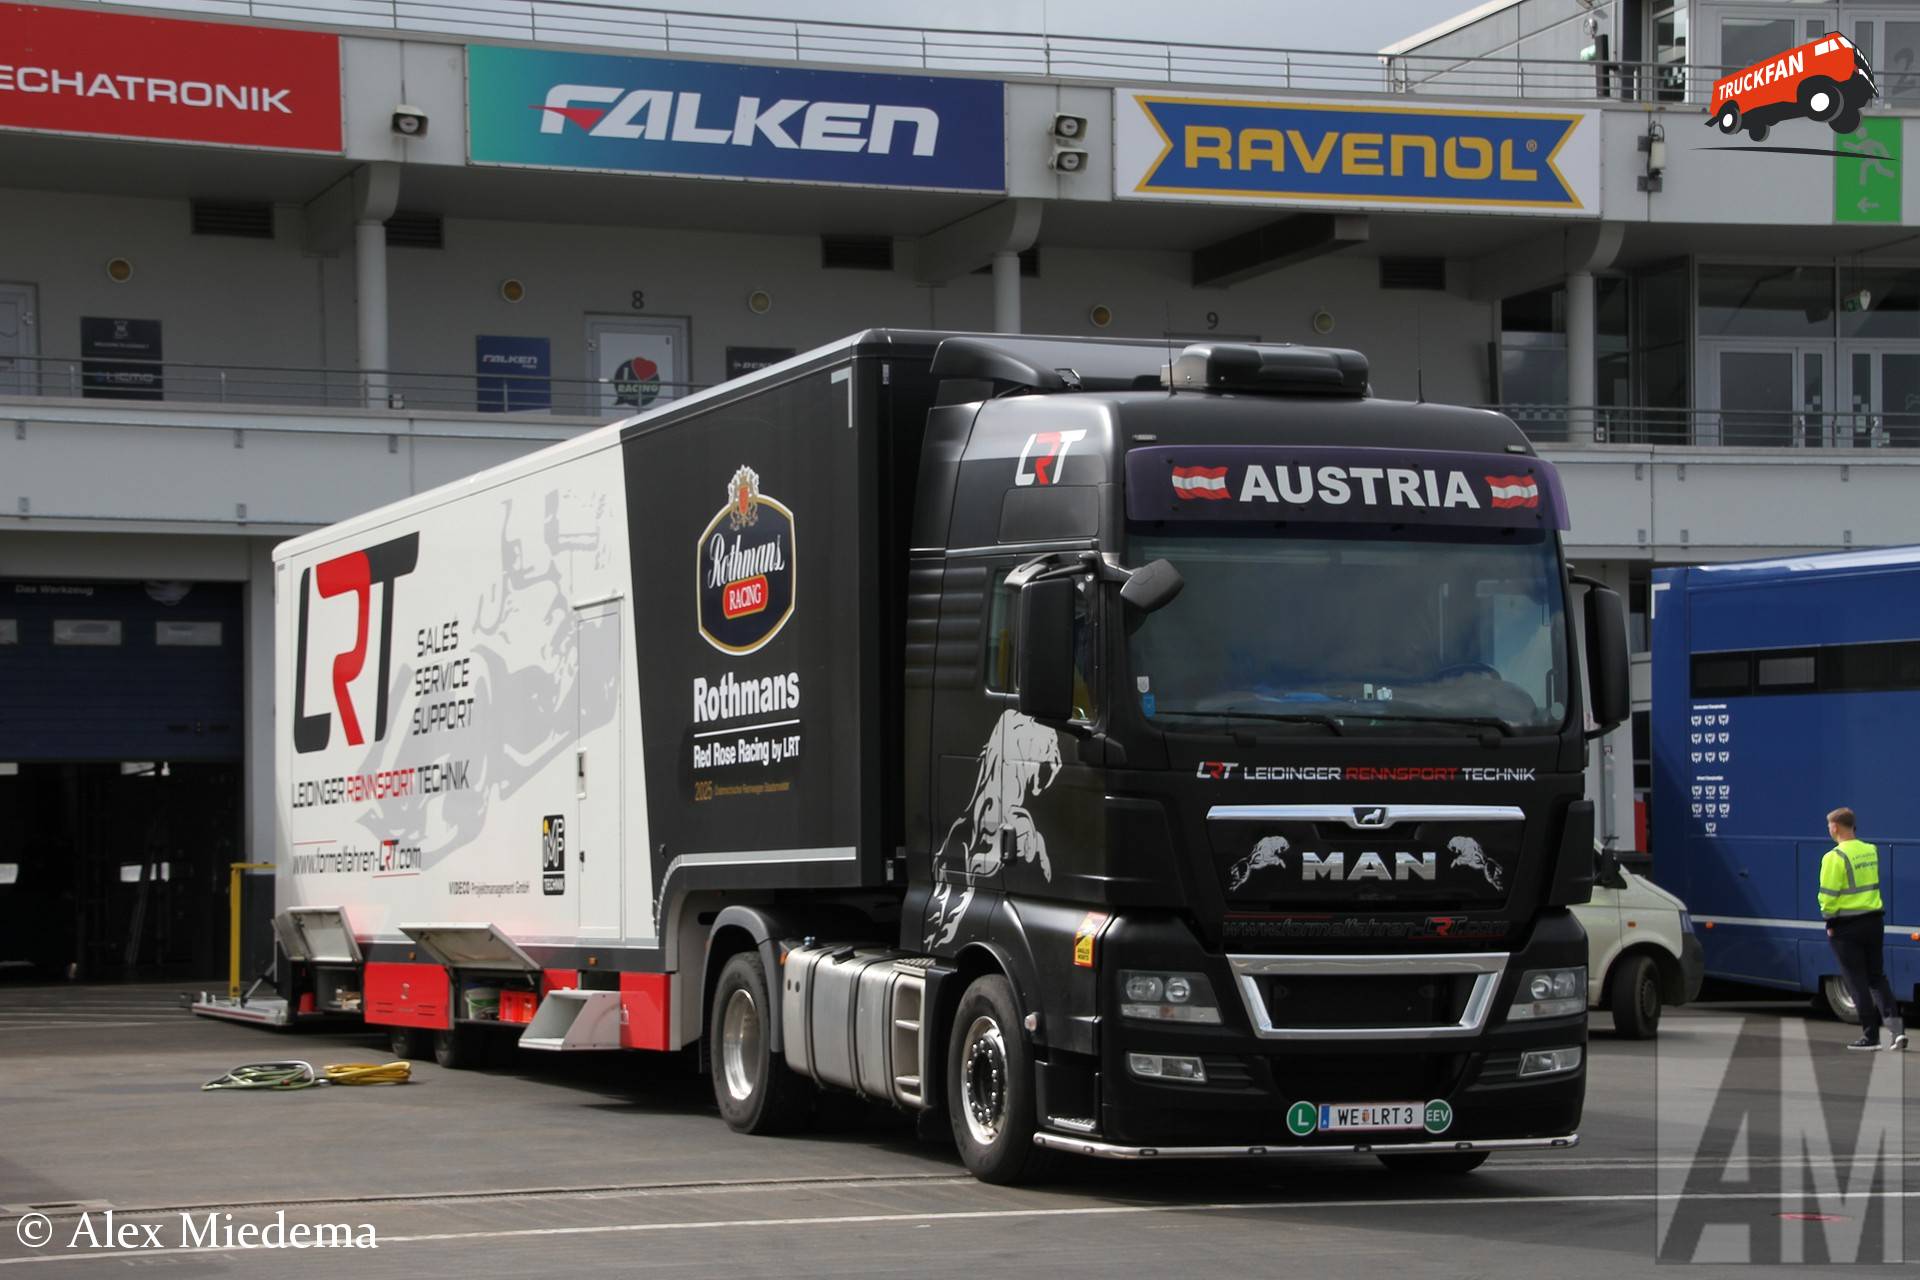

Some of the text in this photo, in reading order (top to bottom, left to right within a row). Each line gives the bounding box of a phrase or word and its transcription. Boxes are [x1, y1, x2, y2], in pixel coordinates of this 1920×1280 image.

[531, 84, 940, 157] FALKEN
[631, 290, 645, 309] 8
[1206, 311, 1220, 330] 9
[481, 354, 538, 364] FALKEN
[617, 384, 659, 393] RACING
[1014, 429, 1088, 486] LRT
[1239, 464, 1481, 509] AUSTRIA
[707, 532, 786, 590] Rothmans
[729, 583, 762, 611] RACING
[293, 531, 420, 754] LRT
[416, 620, 460, 658] SALES
[414, 658, 471, 697] SERVICE
[693, 671, 800, 723] Rothmans
[412, 698, 475, 736] SUPPORT
[693, 735, 801, 769] Red Rose Racing by LRT
[291, 759, 471, 808] LEIDINGER RENNSPORT TECHNIK
[1195, 761, 1536, 782] LRT LEIDINGER RENNSPORT TECHNIK
[293, 838, 421, 874] www.formelfahren-LRT.com
[1301, 850, 1437, 882] MAN
[1297, 1109, 1310, 1126] L
[1338, 1107, 1413, 1126] WE LRT 3
[1426, 1109, 1450, 1122] EEV
